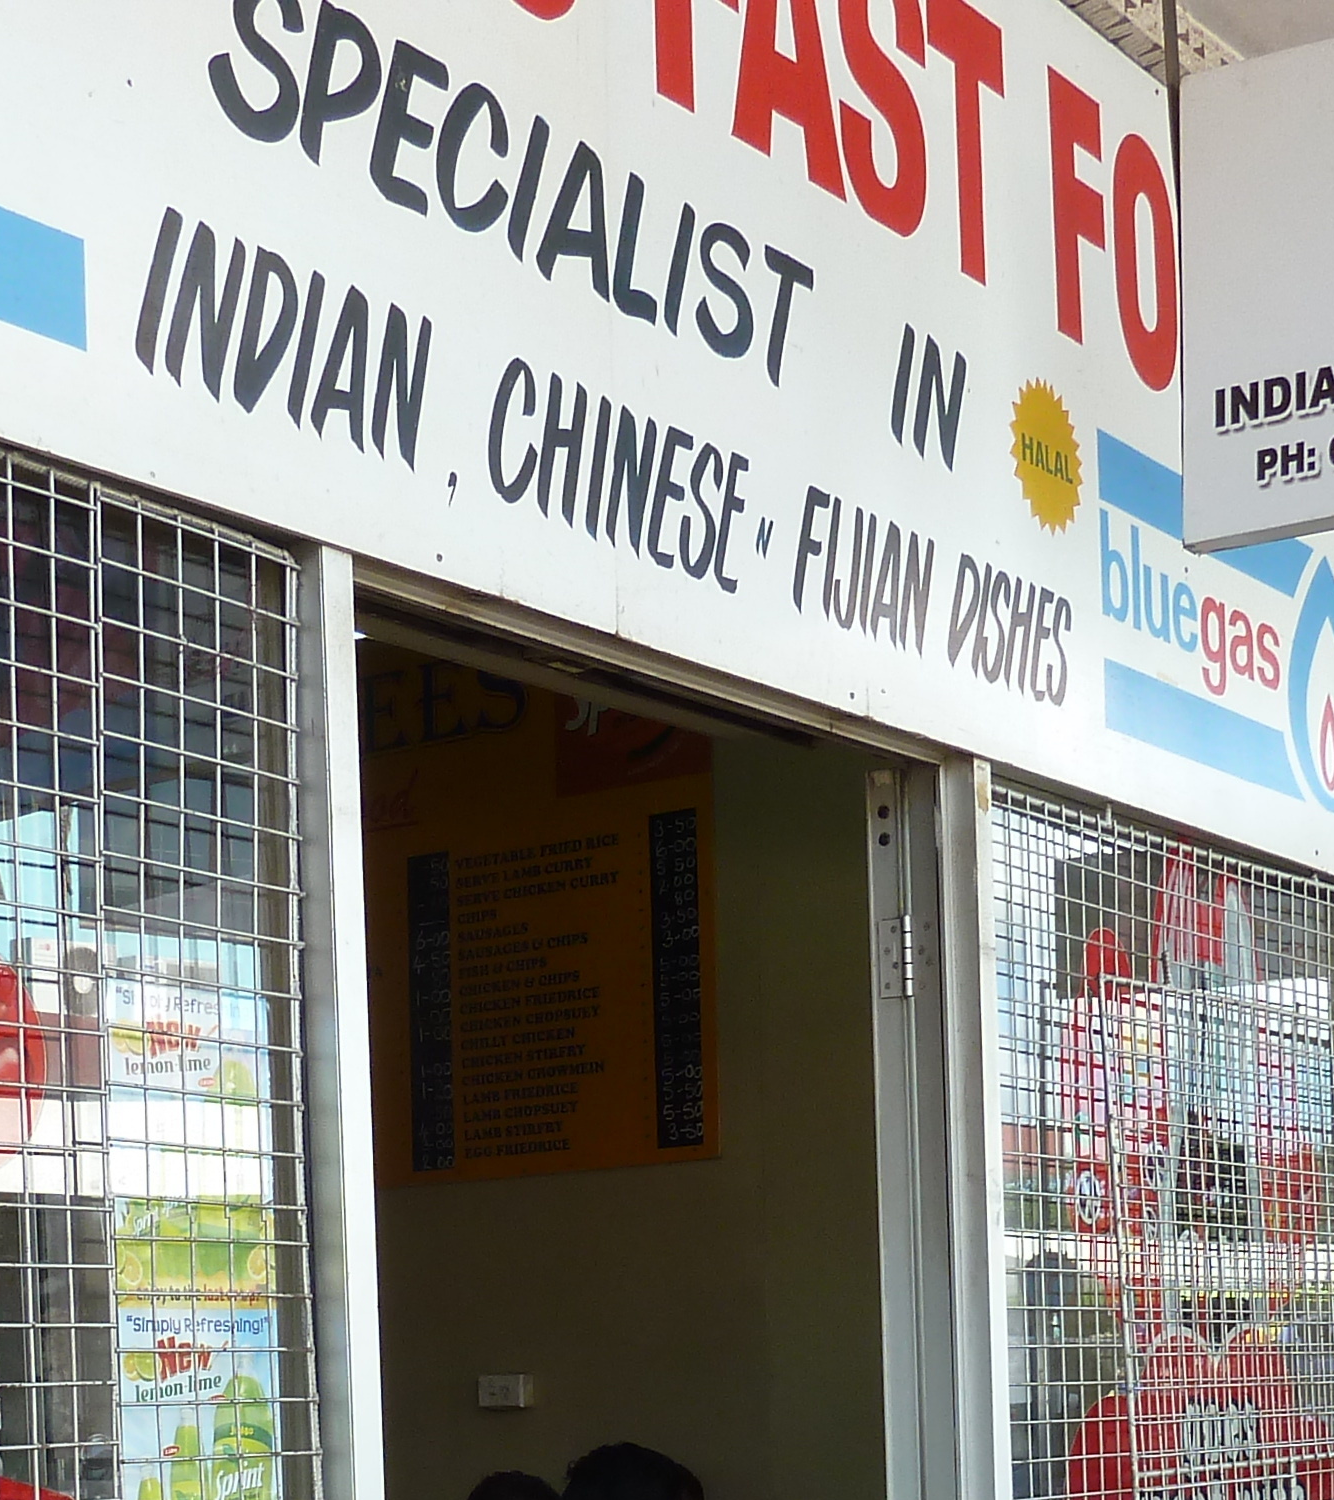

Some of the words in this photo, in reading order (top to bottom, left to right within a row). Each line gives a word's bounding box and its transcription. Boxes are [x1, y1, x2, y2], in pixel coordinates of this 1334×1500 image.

[208, 0, 815, 388] SPECIALIST
[890, 322, 968, 472] IN
[1021, 431, 1074, 486] HALAL
[1255, 439, 1317, 482] PH:
[488, 356, 752, 597] CHINESE
[793, 486, 938, 658] FIJIAN
[946, 551, 1072, 709] DISHES
[1099, 507, 1281, 697] bluegas
[455, 846, 536, 871] VEGETABLE
[539, 839, 582, 858] FRIED
[586, 833, 620, 850] RICE
[503, 864, 541, 882] LAMB
[545, 856, 593, 876] CURRY
[504, 879, 567, 900] CHICKEN
[570, 871, 620, 890] CURRY
[457, 909, 498, 925] CHIPS
[457, 922, 529, 943] SAUSAGES
[458, 940, 530, 961] SAUSAGES
[547, 932, 589, 950] CHIPS
[458, 964, 490, 980] FISH
[506, 956, 548, 972] CHIPS
[459, 978, 521, 998] CHICKEN
[538, 970, 580, 987] CHIPS
[459, 998, 521, 1016] CHICKEN
[460, 1016, 522, 1033] CHICKEN
[525, 1004, 601, 1024] CHOPSUEY
[461, 1034, 508, 1051] CHILLY
[513, 1027, 576, 1044] CHICKEN
[462, 1052, 523, 1070] CHICKEN
[463, 1070, 523, 1087] CHICKEN
[463, 1090, 501, 1105] LAMB
[463, 1108, 501, 1123] LAMB
[504, 1100, 579, 1119] CHOPSUEY
[464, 1126, 502, 1142] LAMB
[464, 1144, 493, 1160] EGG
[156, 1335, 213, 1384] New
